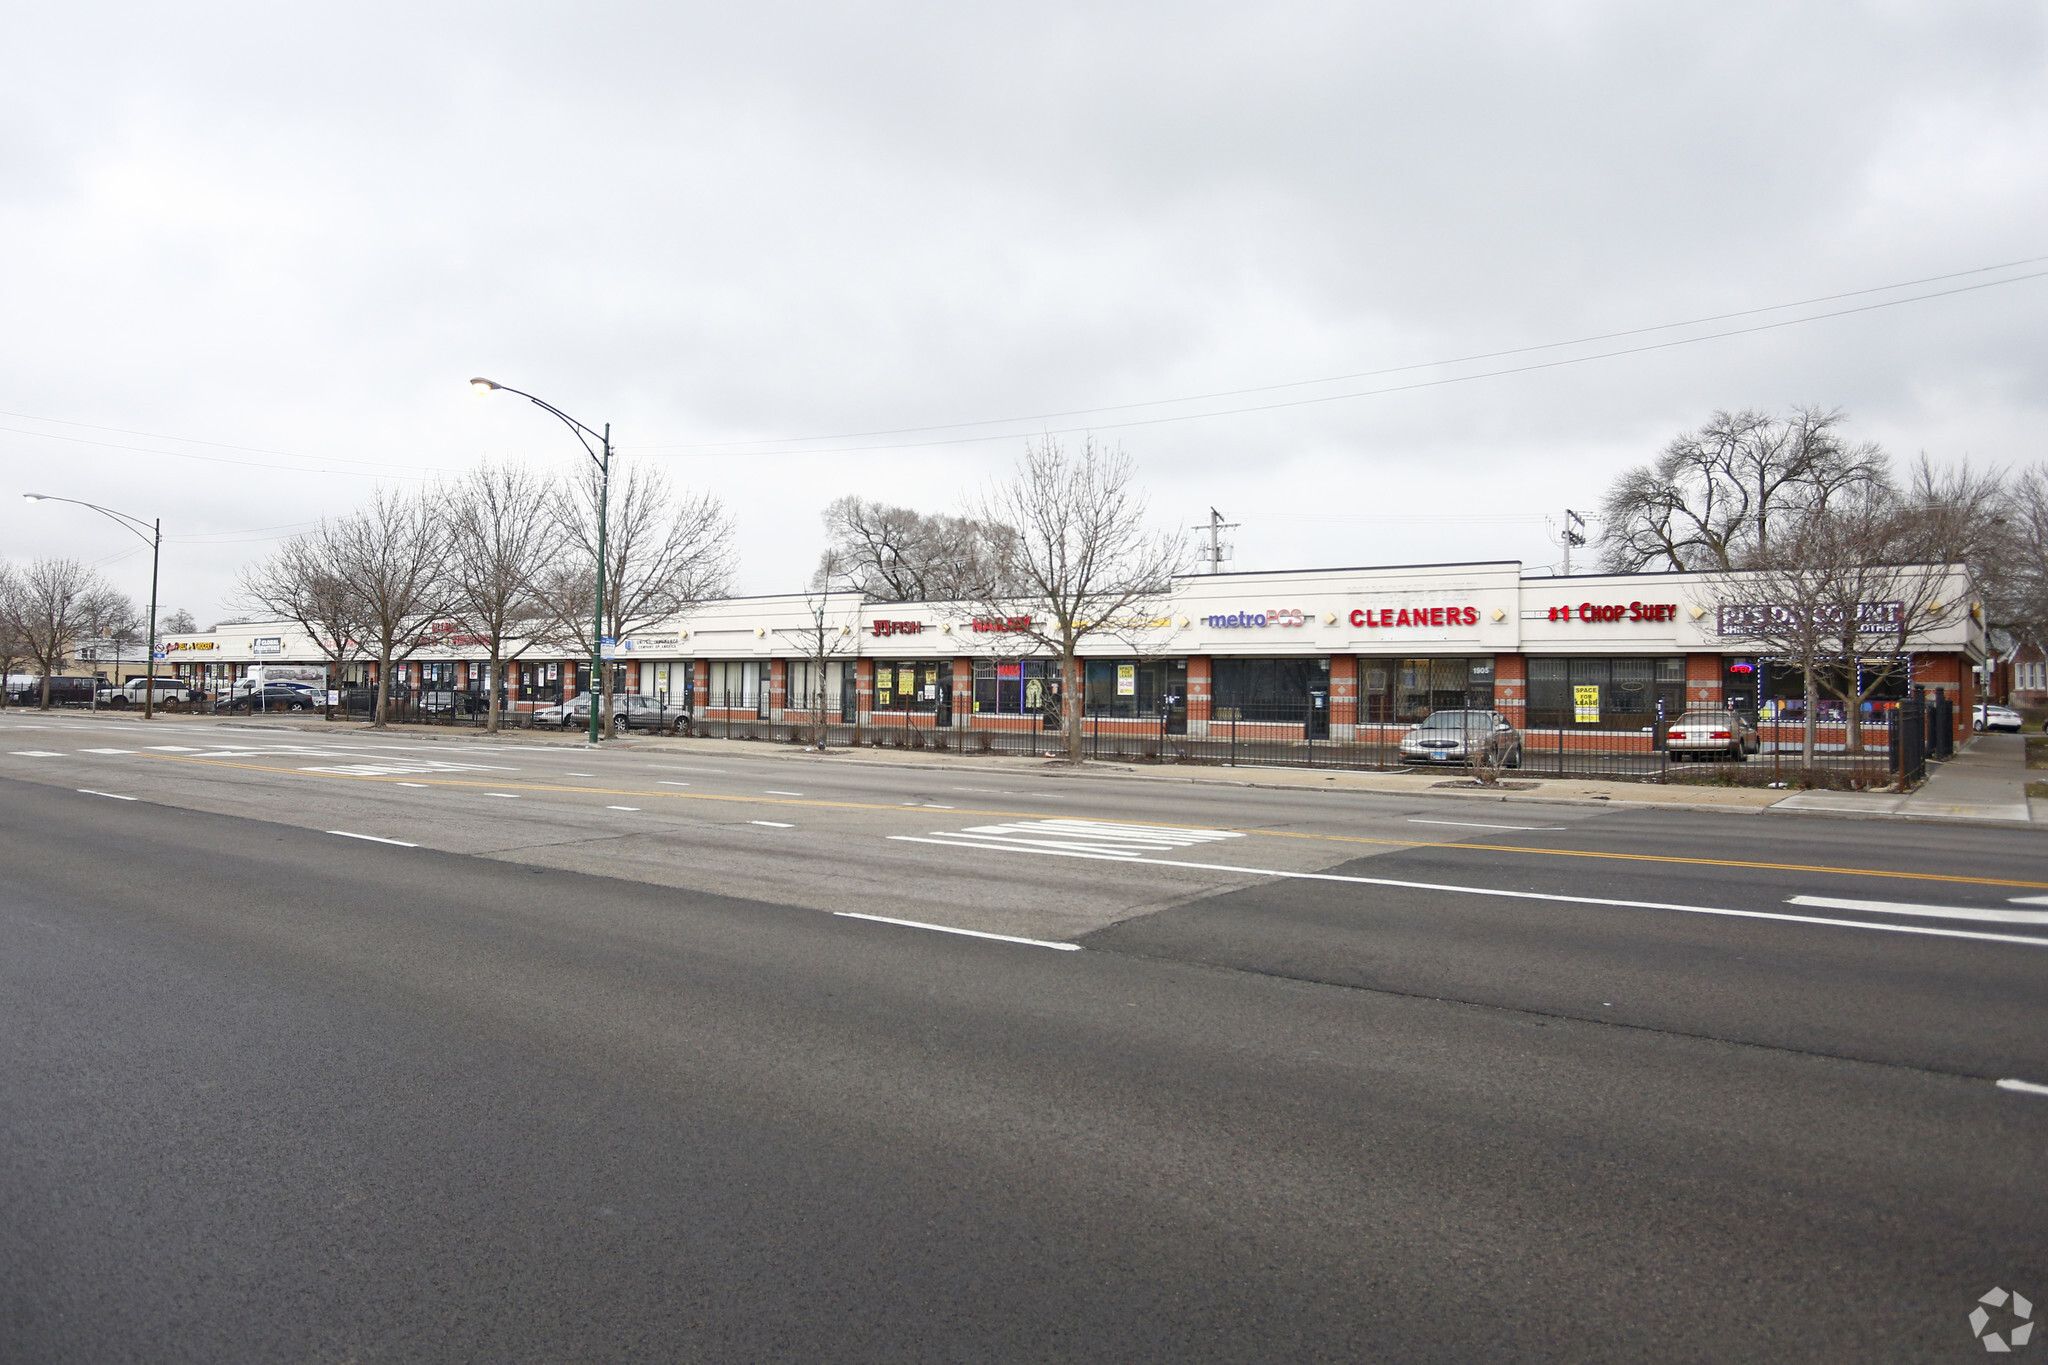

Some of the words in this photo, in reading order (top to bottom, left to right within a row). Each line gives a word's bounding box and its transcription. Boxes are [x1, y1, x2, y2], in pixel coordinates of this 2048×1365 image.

[1208, 609, 1304, 627] metroPCS
[1350, 606, 1477, 627] CLEANERS
[1548, 605, 1570, 621] #1
[1579, 602, 1626, 622] CHOP
[1629, 601, 1676, 621] SUEY
[1771, 603, 1900, 623] DICOUNT
[891, 621, 922, 634] FISH
[1855, 623, 1899, 632] LOTHES
[1730, 665, 1751, 674] OPEN
